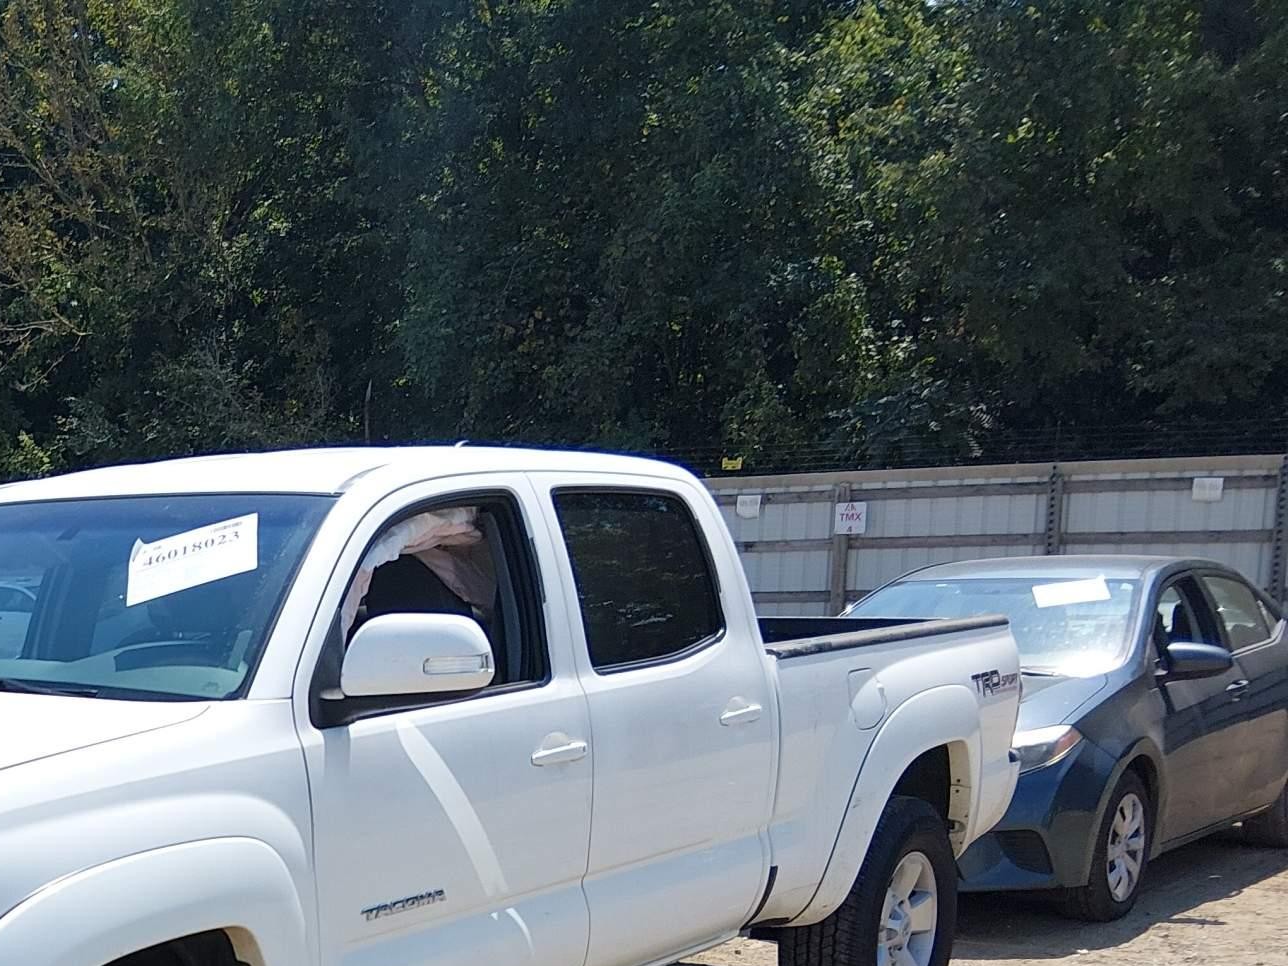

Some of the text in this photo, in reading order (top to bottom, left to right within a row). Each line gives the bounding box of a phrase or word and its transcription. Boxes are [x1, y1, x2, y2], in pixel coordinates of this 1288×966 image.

[840, 512, 862, 521] TMX
[143, 531, 240, 566] 46018023
[971, 670, 1001, 697] TRD
[360, 889, 446, 921] TACOMA
